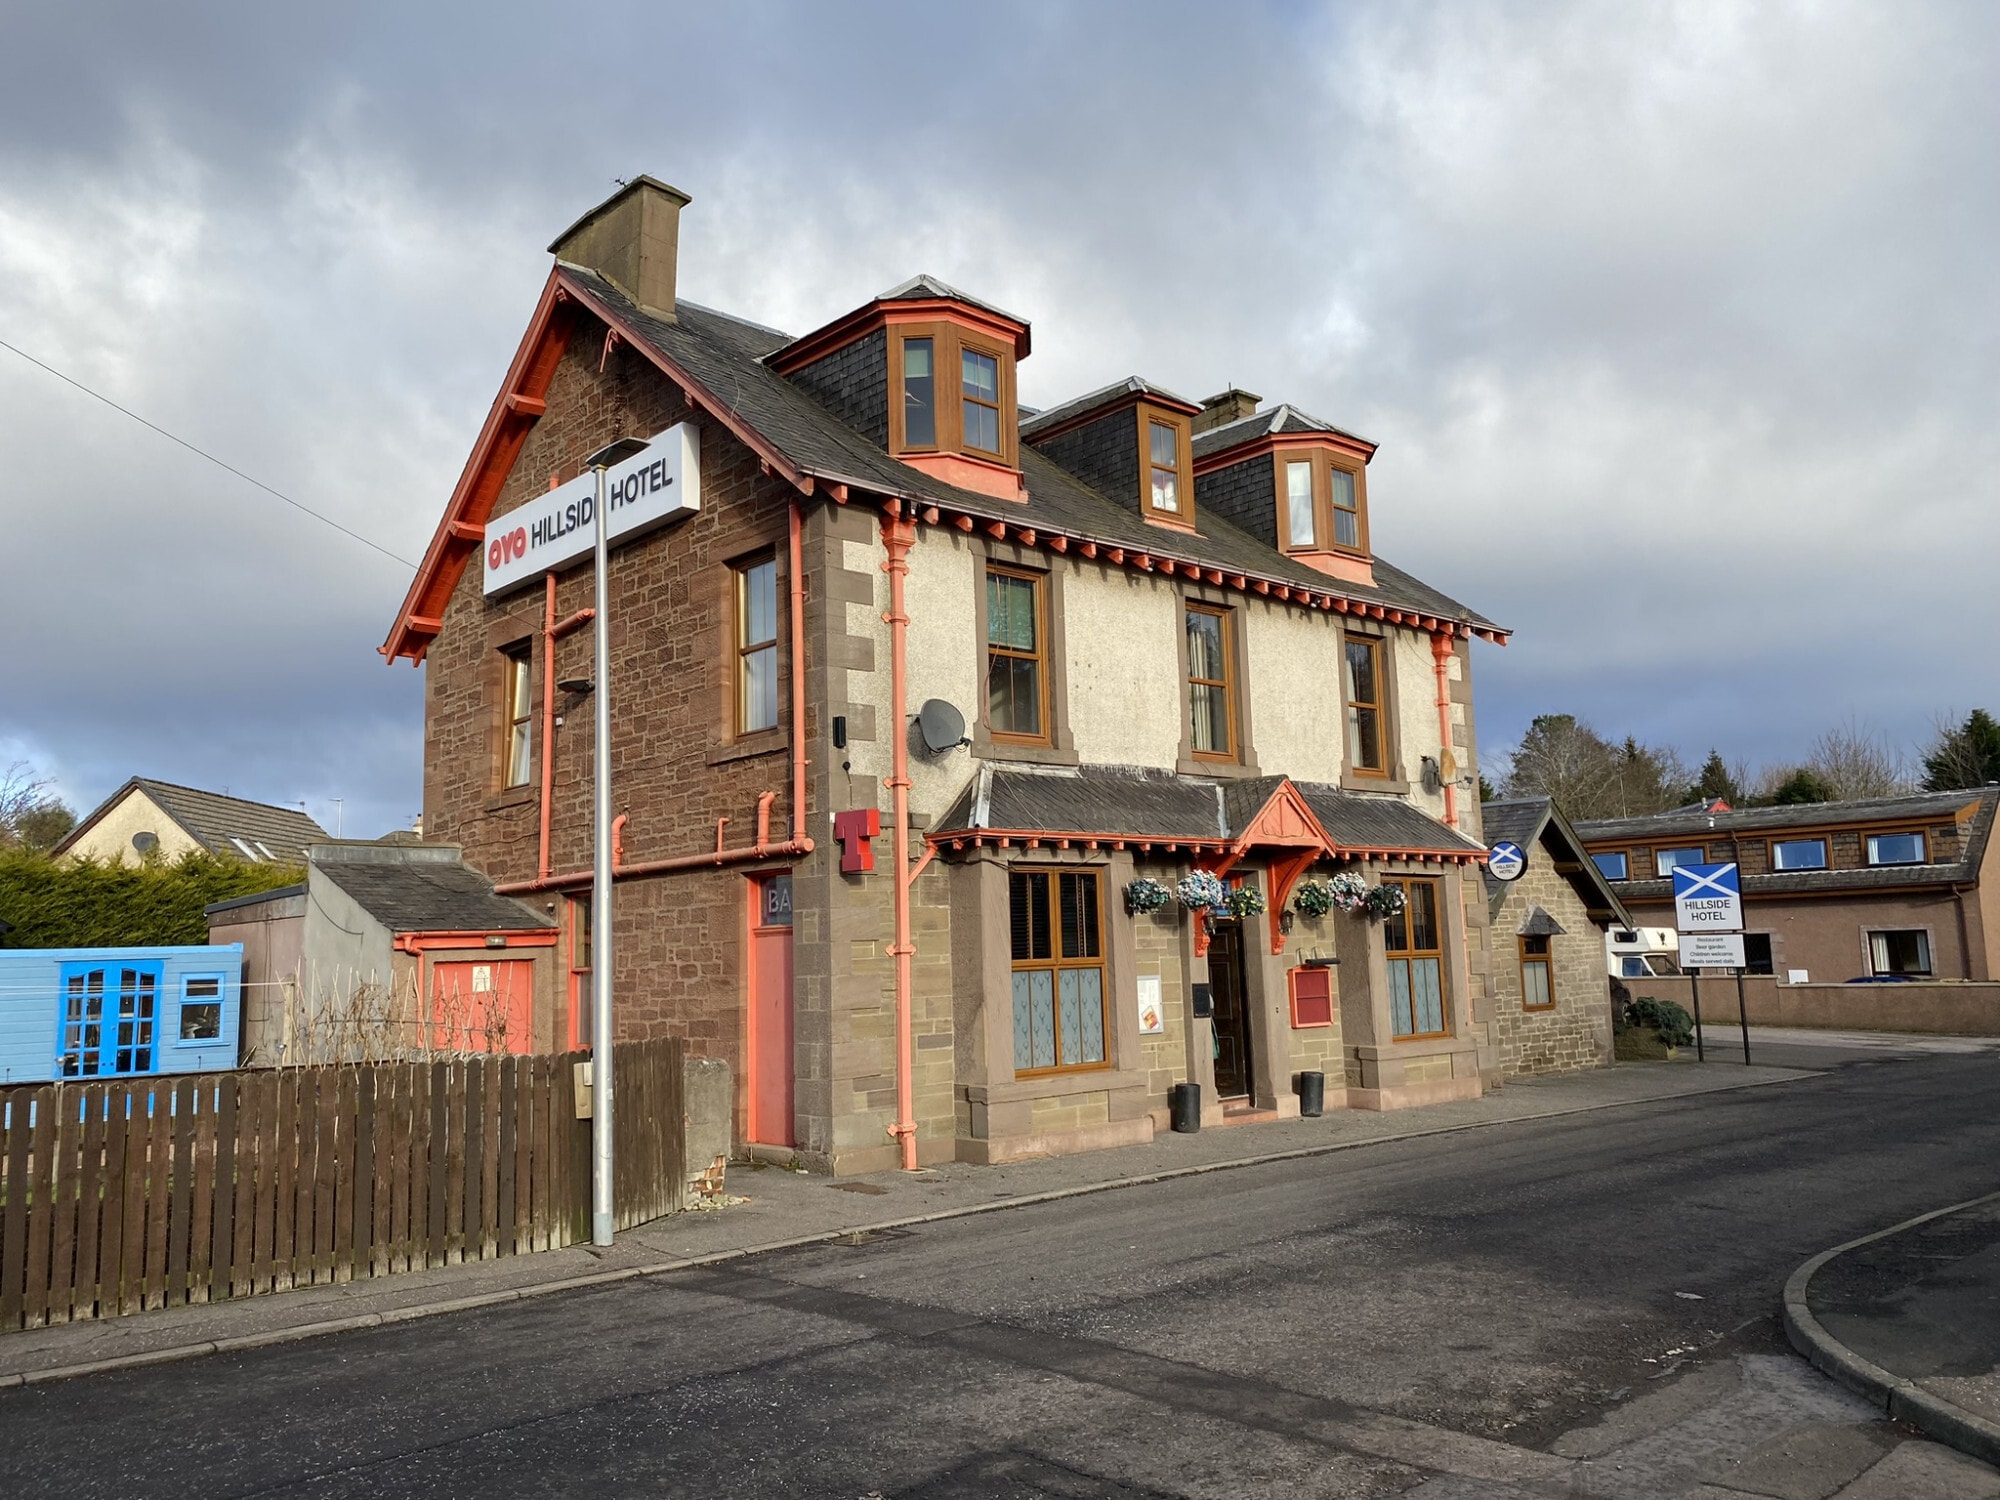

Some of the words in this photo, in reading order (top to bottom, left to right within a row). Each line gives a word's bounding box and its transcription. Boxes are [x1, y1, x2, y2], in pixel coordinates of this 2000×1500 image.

[488, 526, 526, 570] OYO
[531, 492, 597, 549] HILLSID
[610, 457, 673, 511] HOTEL
[768, 888, 792, 913] BA
[1684, 899, 1731, 910] HILLSIDE
[1691, 911, 1726, 921] HOTEL
